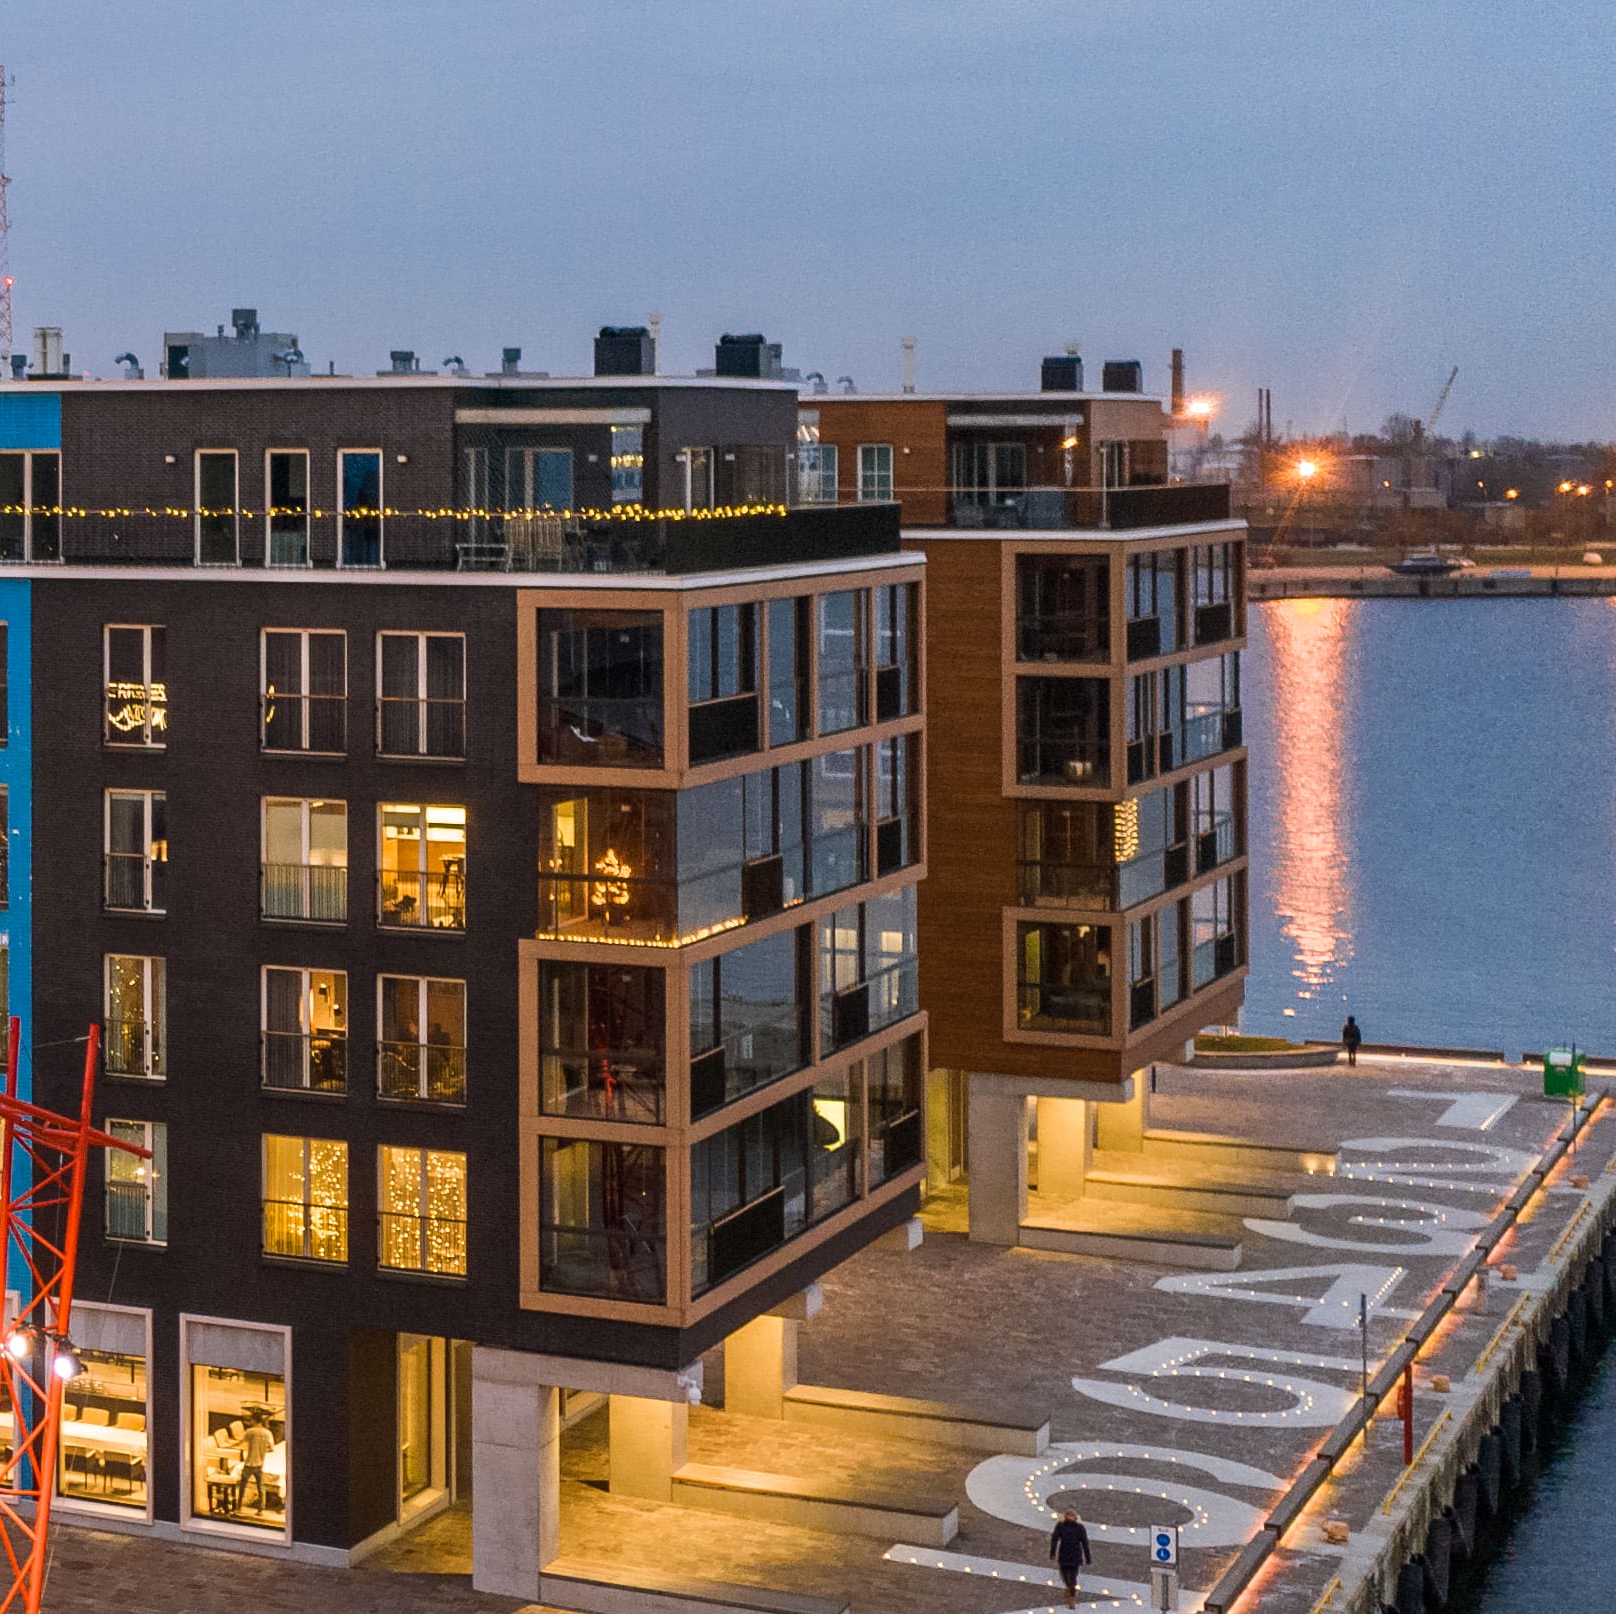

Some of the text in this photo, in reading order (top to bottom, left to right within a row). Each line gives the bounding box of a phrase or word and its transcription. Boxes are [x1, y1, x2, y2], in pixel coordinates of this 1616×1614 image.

[1385, 1089, 1521, 1131] 1
[1336, 1137, 1542, 1193] 2
[1243, 1194, 1491, 1256] 3
[1153, 1263, 1425, 1328] 4
[1072, 1336, 1374, 1428] 5
[965, 1442, 1291, 1548] 6
